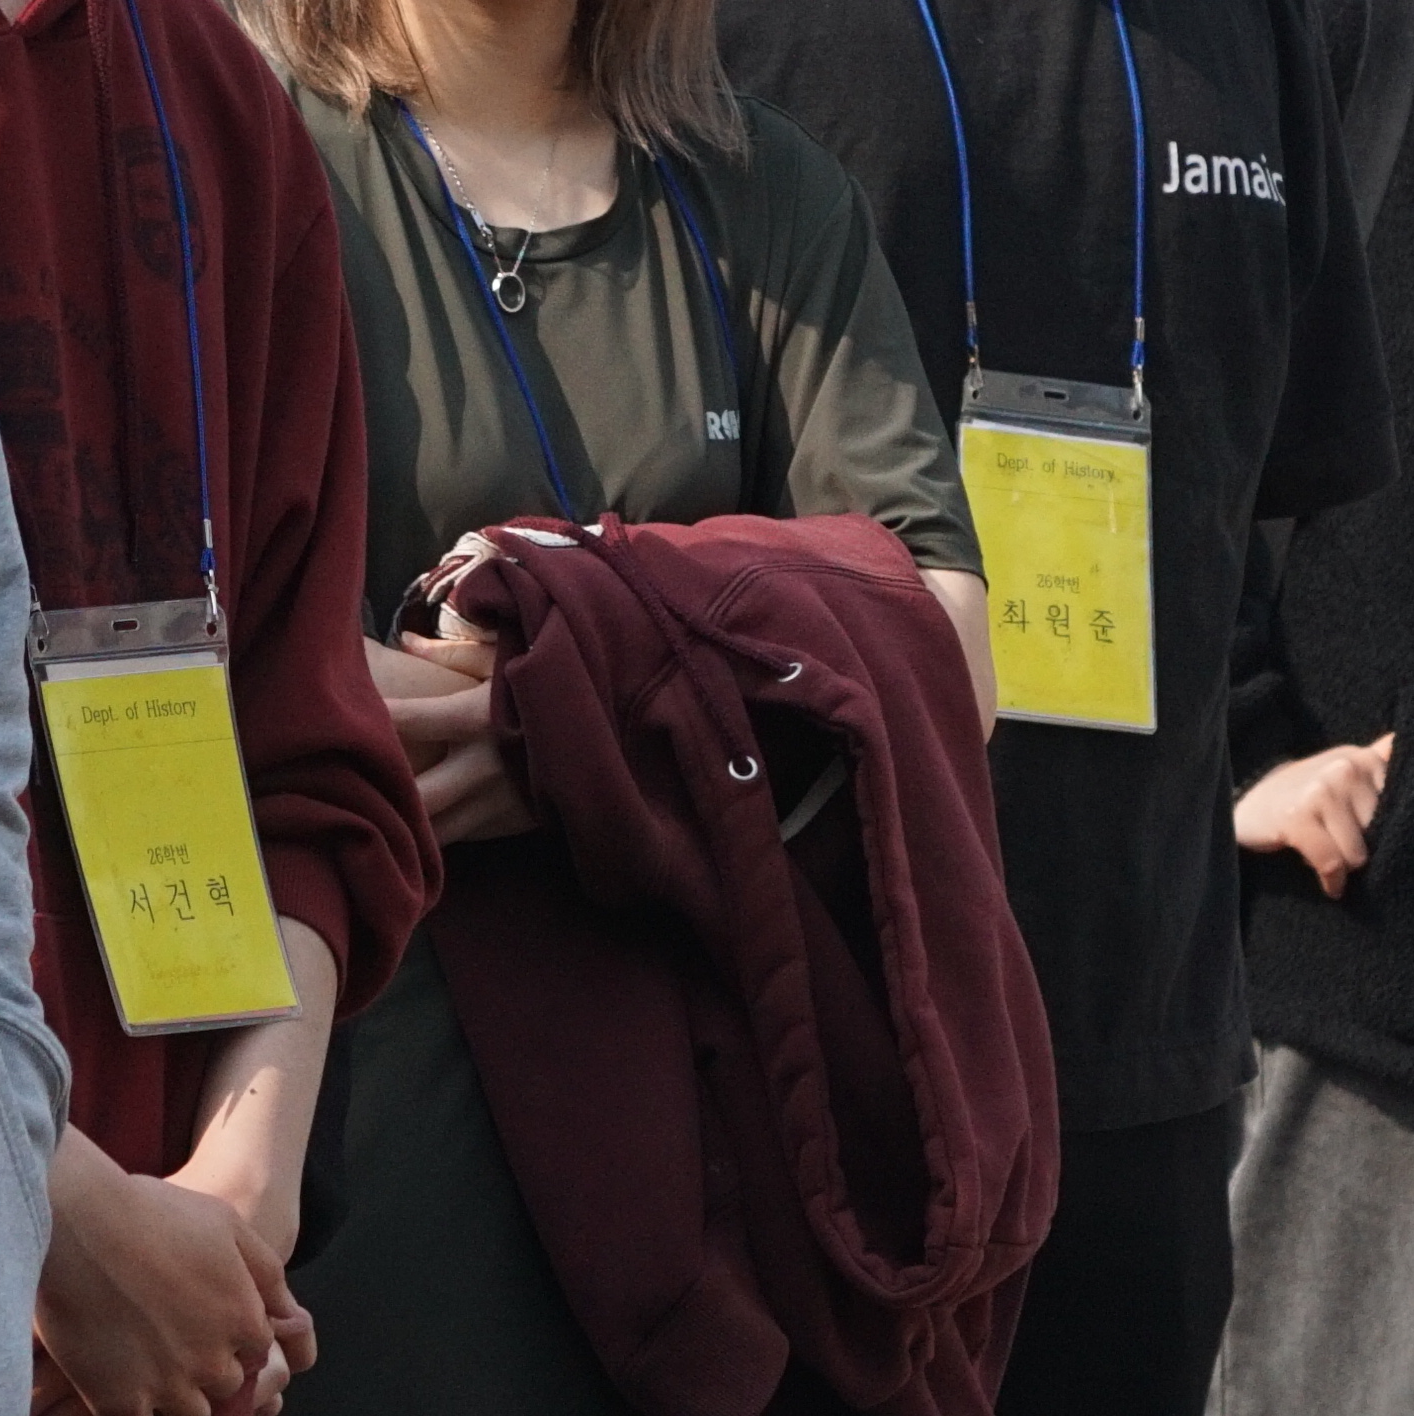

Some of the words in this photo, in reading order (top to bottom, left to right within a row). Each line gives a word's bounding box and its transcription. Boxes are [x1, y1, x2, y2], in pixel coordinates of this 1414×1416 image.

[1041, 458, 1056, 474] of
[1063, 460, 1116, 483] History
[1036, 573, 1081, 594] 26학번
[81, 705, 119, 726] Dept.
[125, 701, 139, 721] of
[145, 698, 197, 719] History
[146, 842, 191, 866] 26학번
